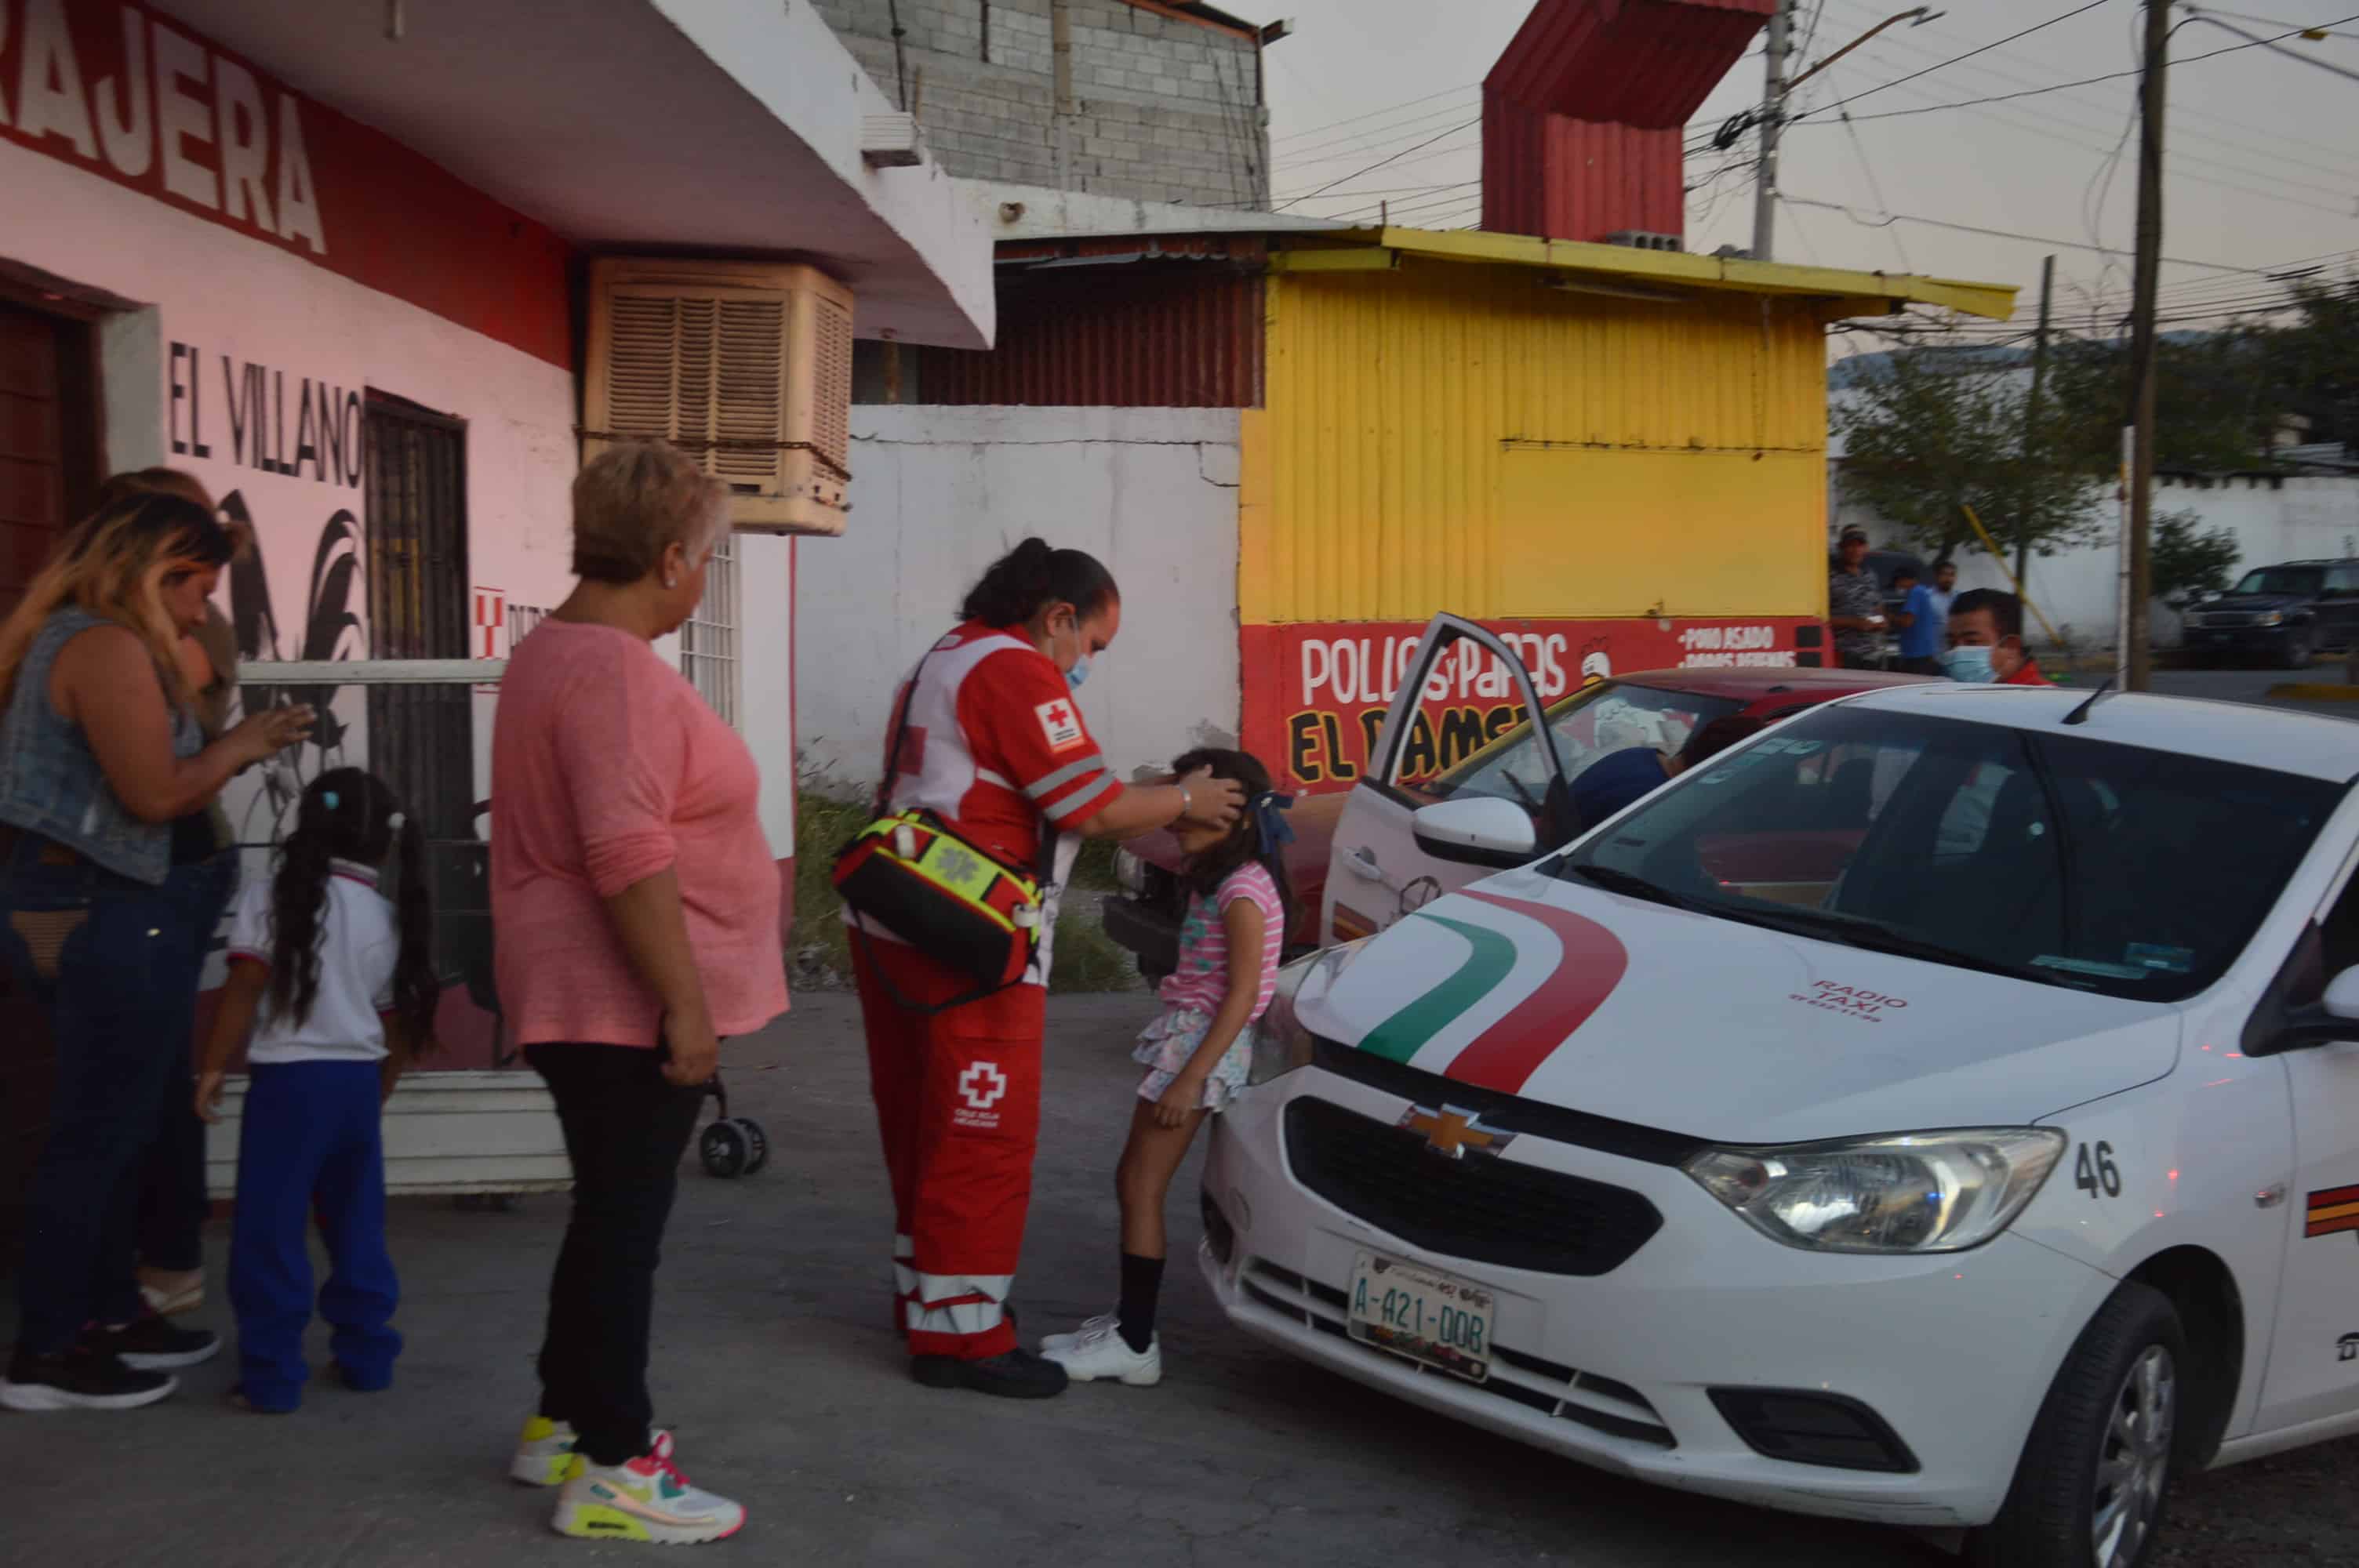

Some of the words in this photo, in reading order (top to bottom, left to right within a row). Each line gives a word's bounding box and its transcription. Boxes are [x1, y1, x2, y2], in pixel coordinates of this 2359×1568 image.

[0, 0, 326, 255] AJERA
[169, 340, 210, 459] EL
[220, 354, 362, 489] VILLANO
[1445, 657, 1458, 684] Y
[1287, 709, 1357, 783] EL
[1812, 980, 1908, 1008] RADIO
[1816, 991, 1881, 1013] TAXI
[2074, 1140, 2121, 1199] 46
